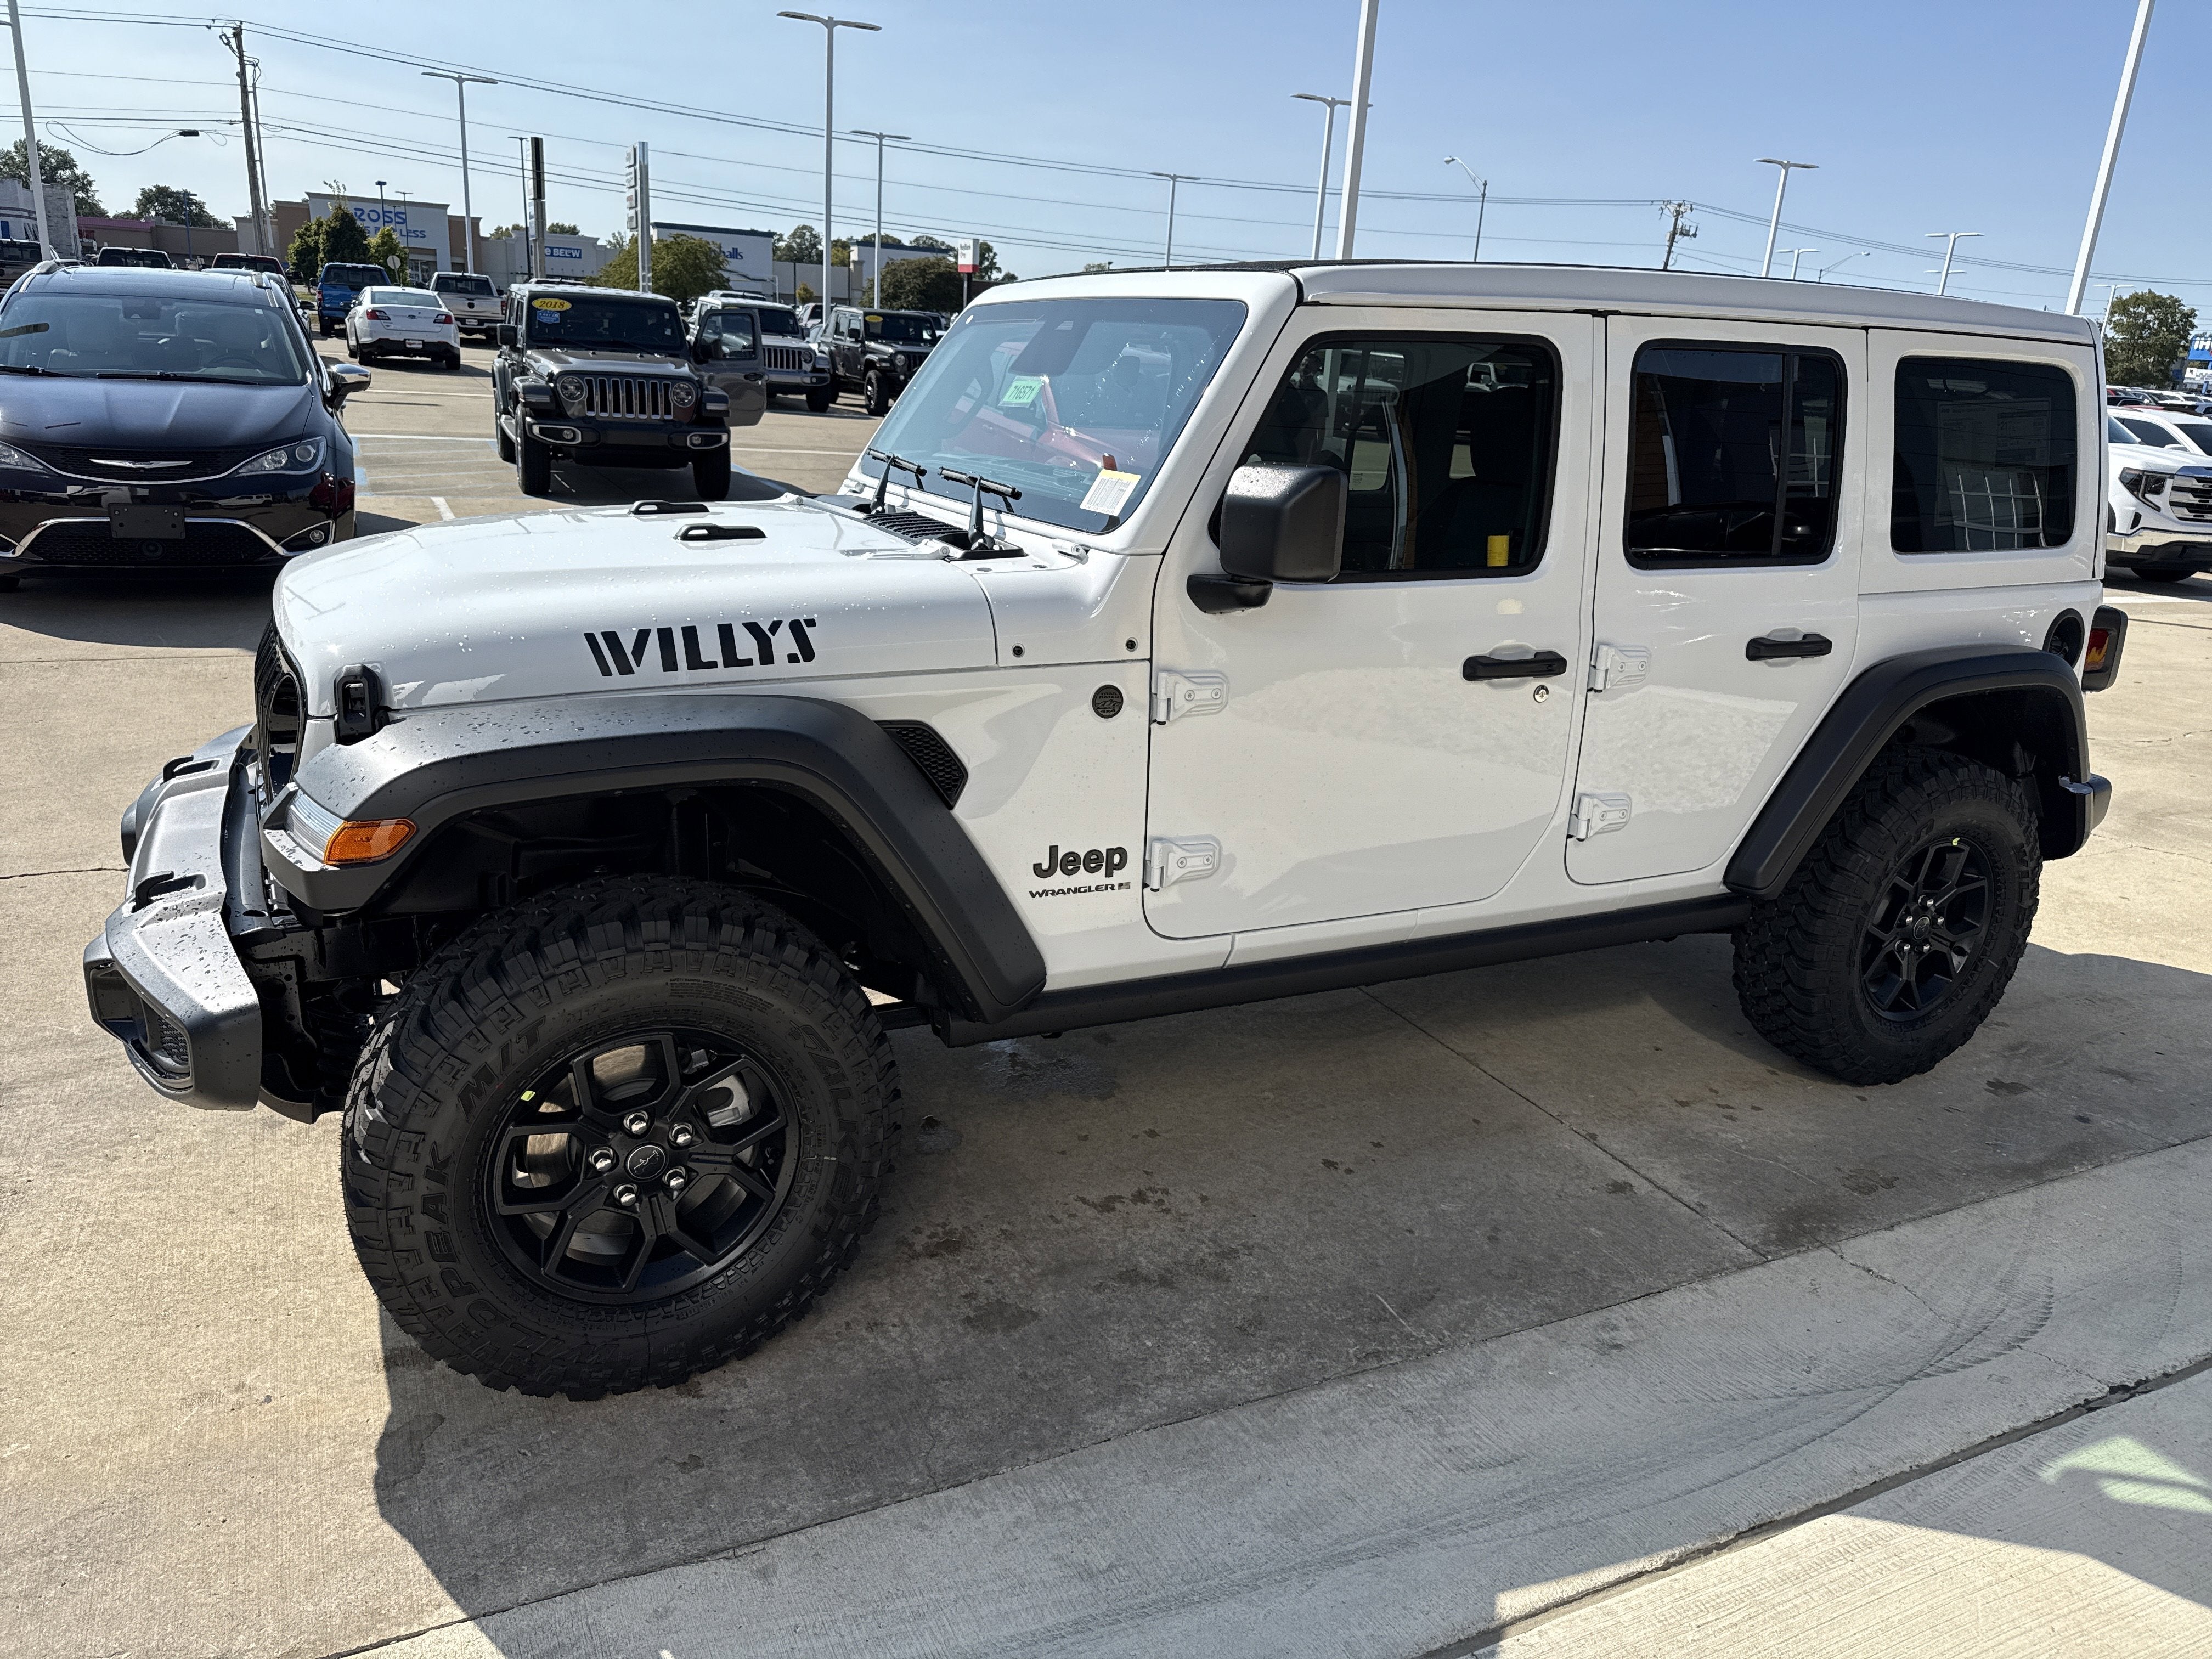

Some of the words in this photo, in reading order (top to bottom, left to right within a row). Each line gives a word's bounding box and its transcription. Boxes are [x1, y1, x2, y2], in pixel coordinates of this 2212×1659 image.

[400, 228, 426, 239] LESS
[552, 247, 580, 258] BELOW
[539, 300, 566, 309] 2018
[1007, 385, 1036, 400] 716571
[583, 618, 817, 677] WILLYS
[1033, 845, 1128, 878] Jeep
[1029, 883, 1115, 898] WRANGLER
[456, 1015, 546, 1123] M/T
[421, 1142, 619, 1365] WILDPEAK
